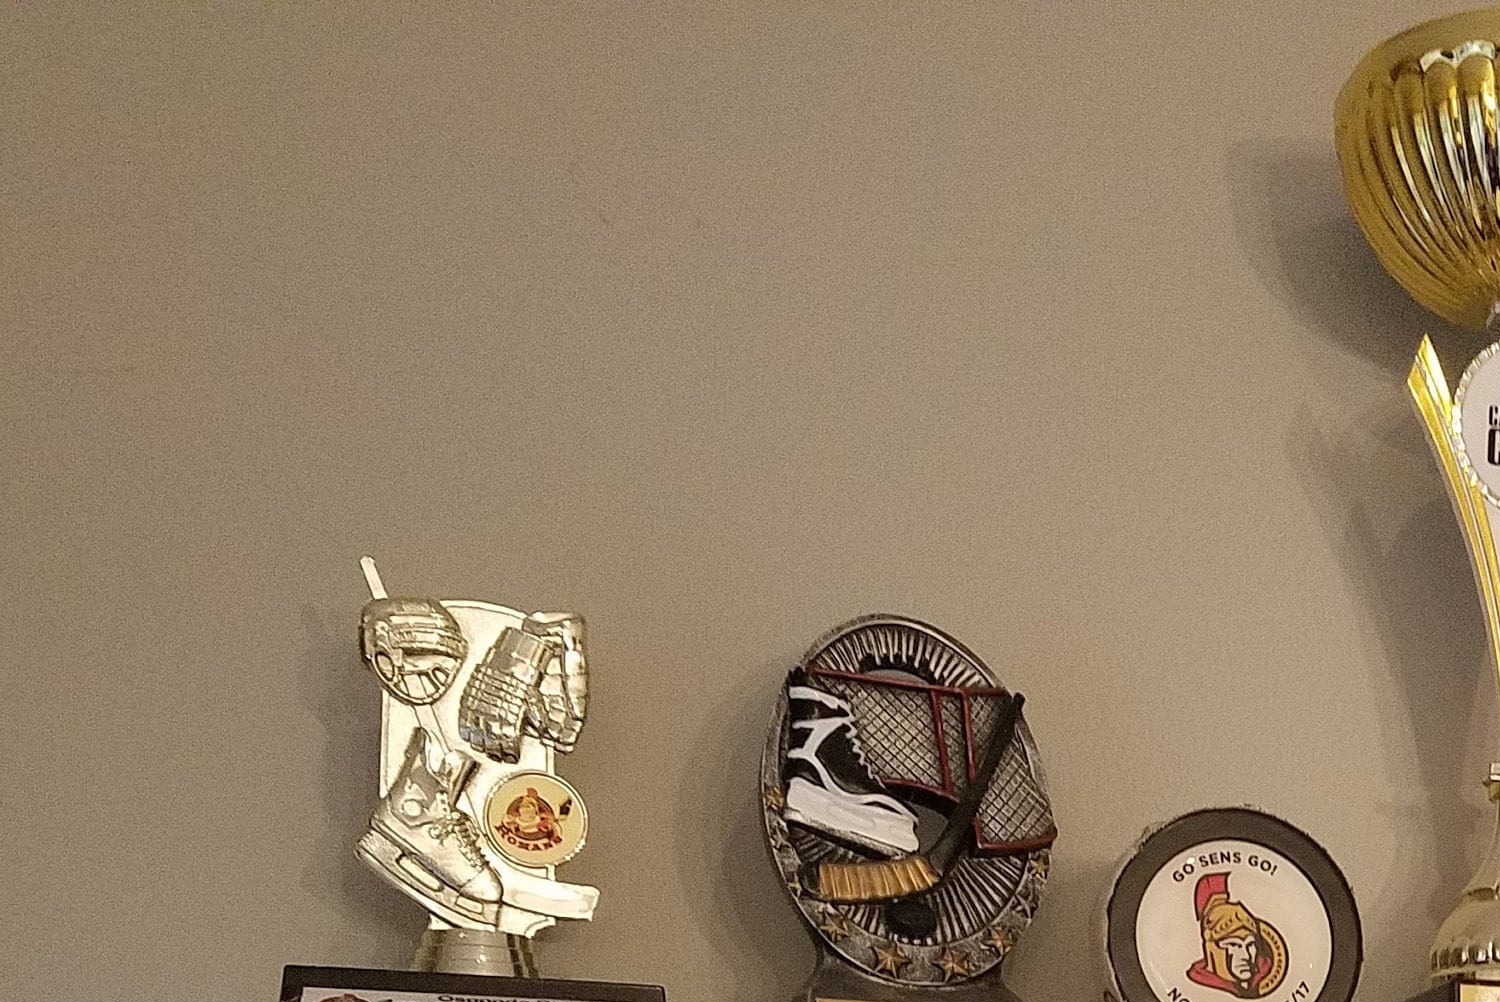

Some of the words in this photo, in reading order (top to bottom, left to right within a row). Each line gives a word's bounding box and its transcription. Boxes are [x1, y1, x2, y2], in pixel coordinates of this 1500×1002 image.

[1173, 860, 1195, 883] GO
[1199, 851, 1241, 867] SENS
[1248, 855, 1278, 876] GO!
